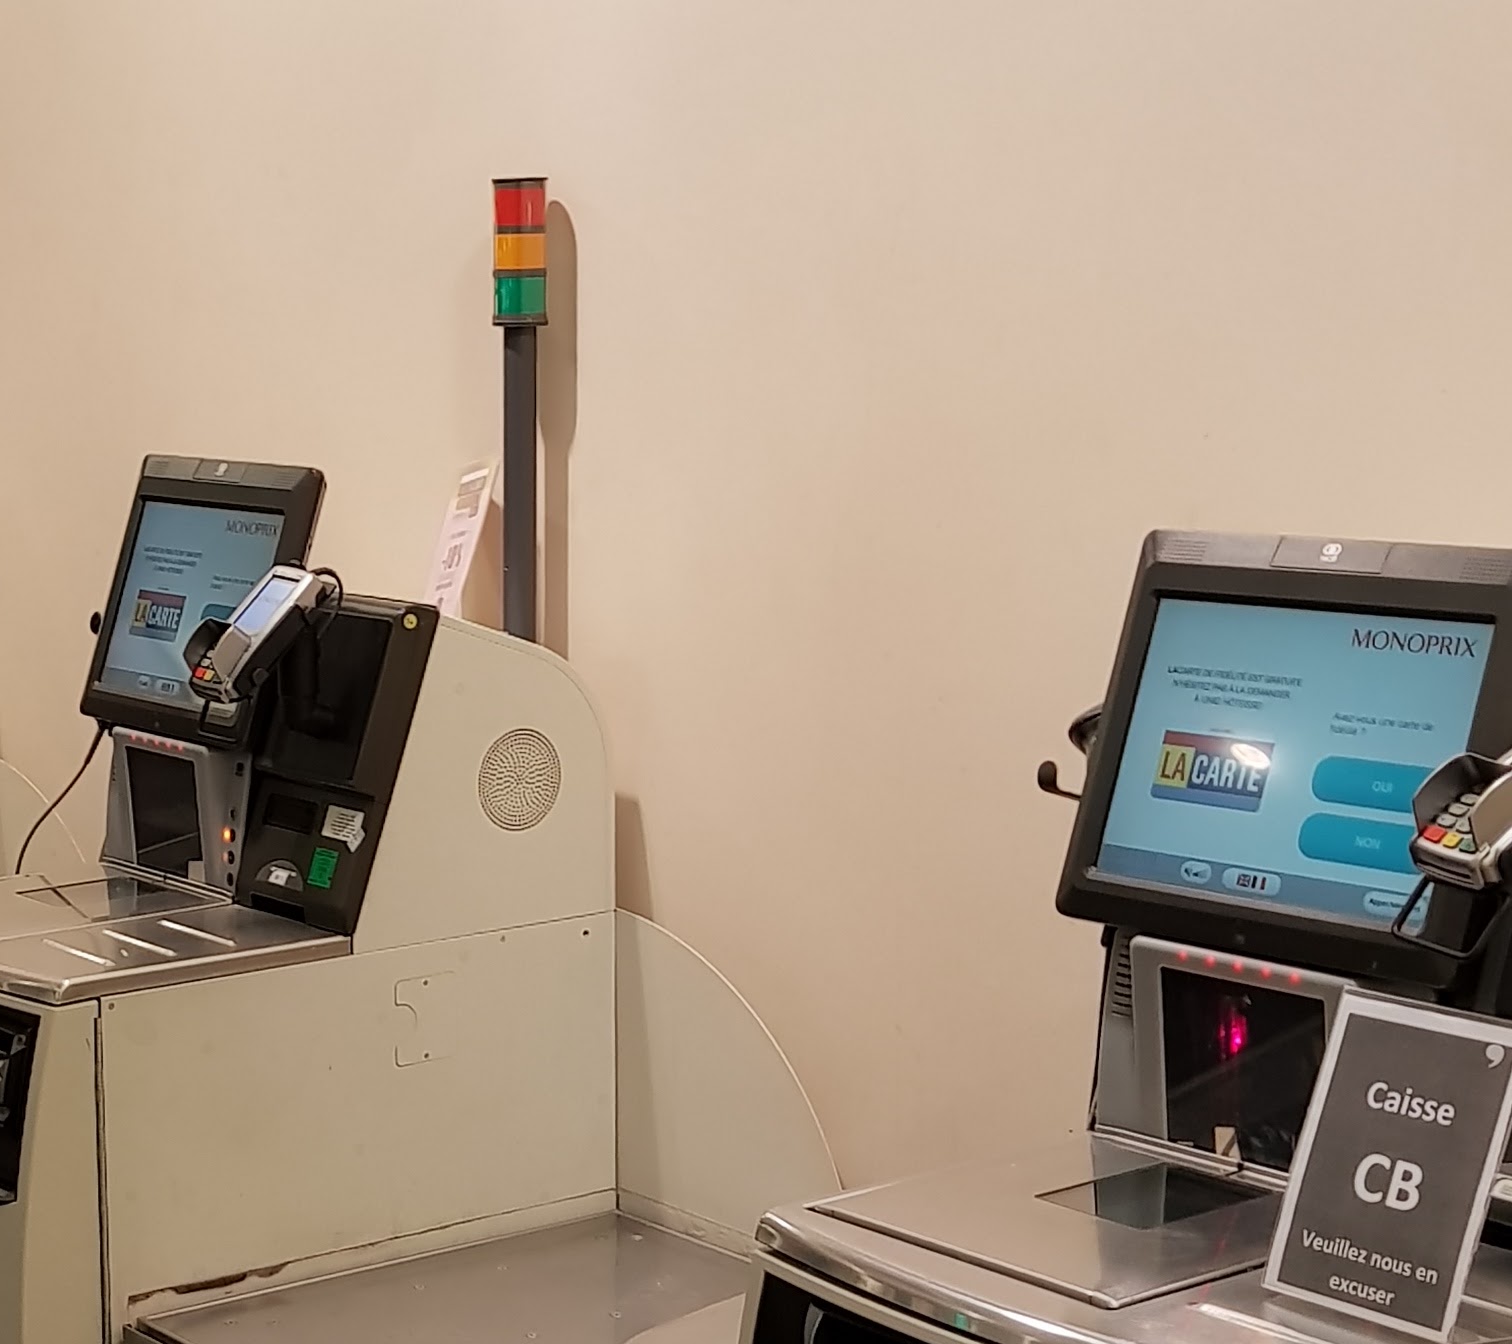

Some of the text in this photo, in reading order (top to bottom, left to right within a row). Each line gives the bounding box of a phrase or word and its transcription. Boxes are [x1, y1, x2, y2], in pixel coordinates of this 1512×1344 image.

[148, 604, 181, 629] CARTE
[1351, 629, 1478, 658] MONOPRIX
[1160, 750, 1261, 793] LA CARTE
[1371, 780, 1393, 793] OUI
[1355, 835, 1381, 850] NON
[1366, 1080, 1457, 1127] Caisse
[1352, 1152, 1425, 1213] CB
[1301, 1228, 1439, 1286] Veuillez nous en
[1329, 1273, 1396, 1307] excuser
